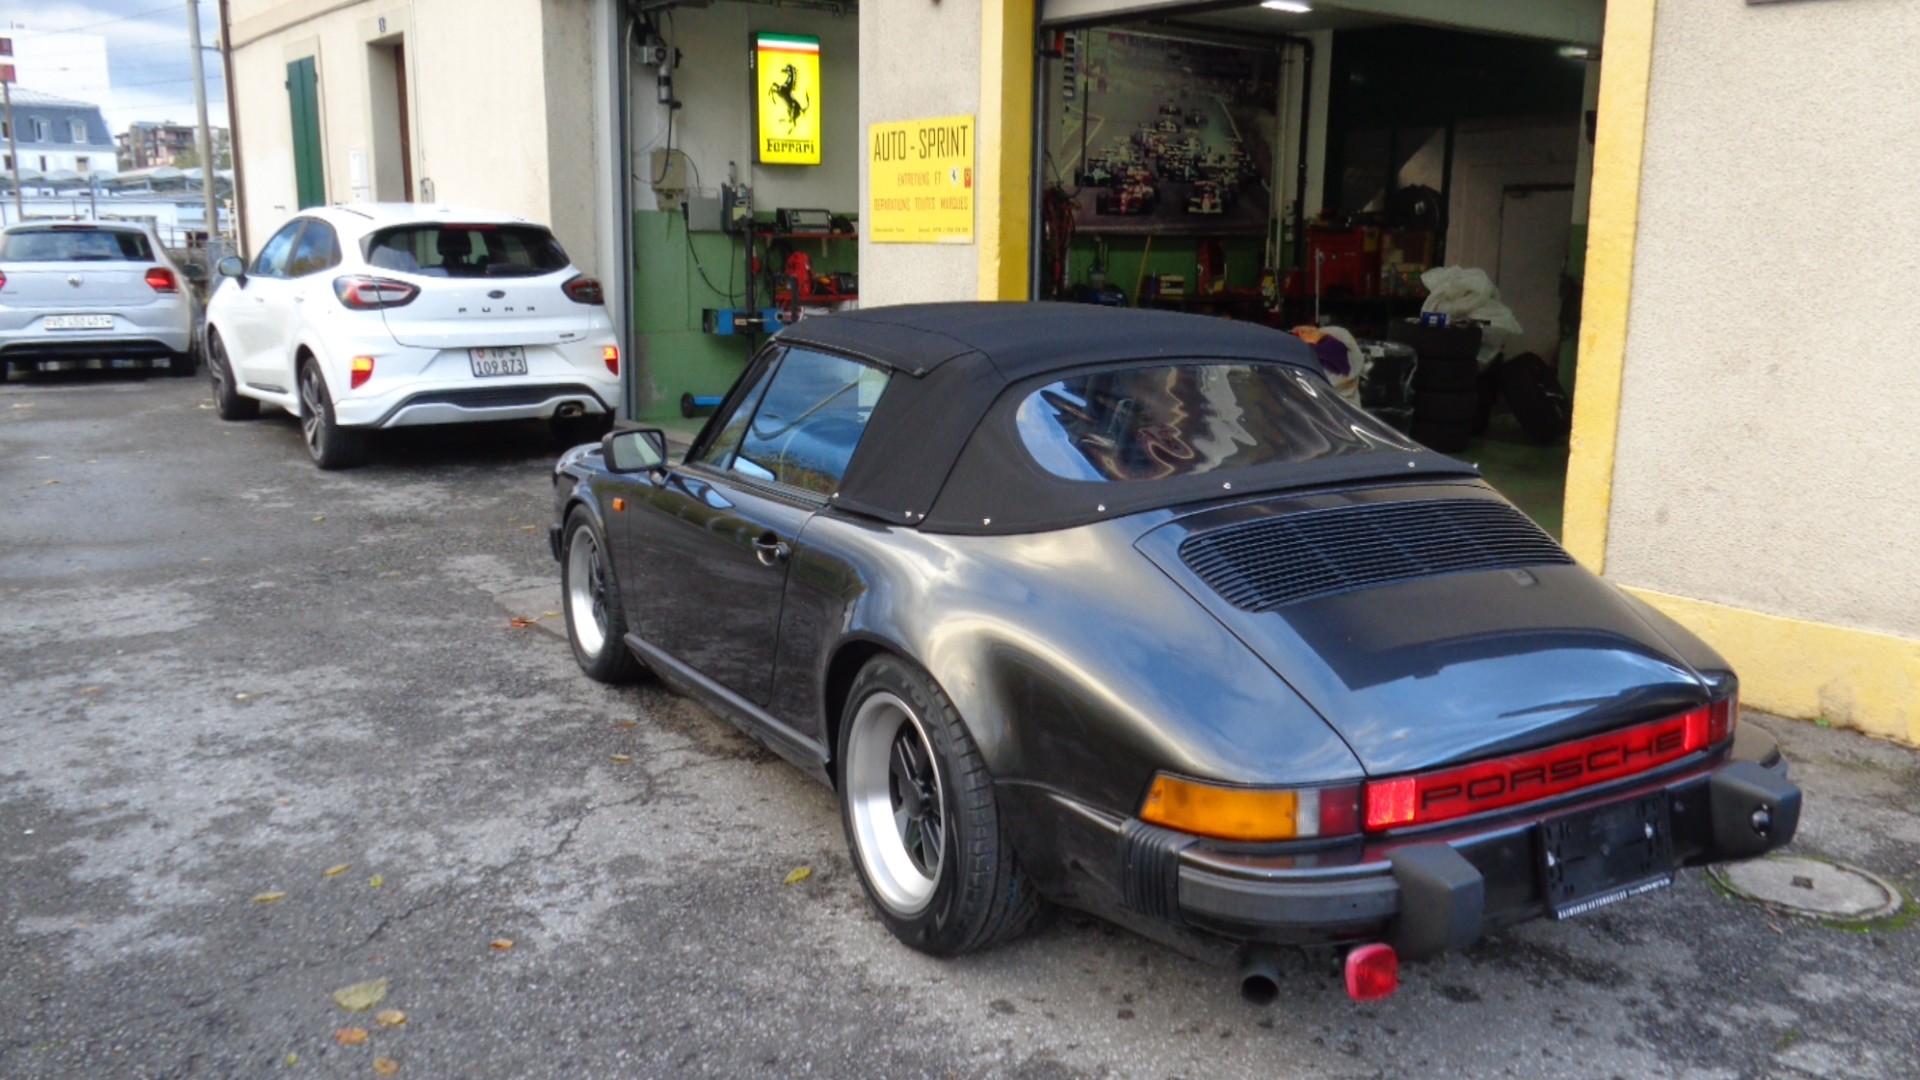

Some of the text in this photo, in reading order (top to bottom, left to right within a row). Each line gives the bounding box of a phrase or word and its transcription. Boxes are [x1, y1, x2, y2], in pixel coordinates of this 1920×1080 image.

[766, 138, 815, 154] Ferrari
[874, 130, 906, 162] AUTO
[919, 125, 968, 159] SPRINT
[897, 171, 942, 187] ENTRETIENS ET
[914, 196, 936, 210] TOUTES
[940, 196, 969, 210] MARQUES
[476, 359, 525, 375] 109 873
[1421, 728, 1684, 811] PORSCHE
